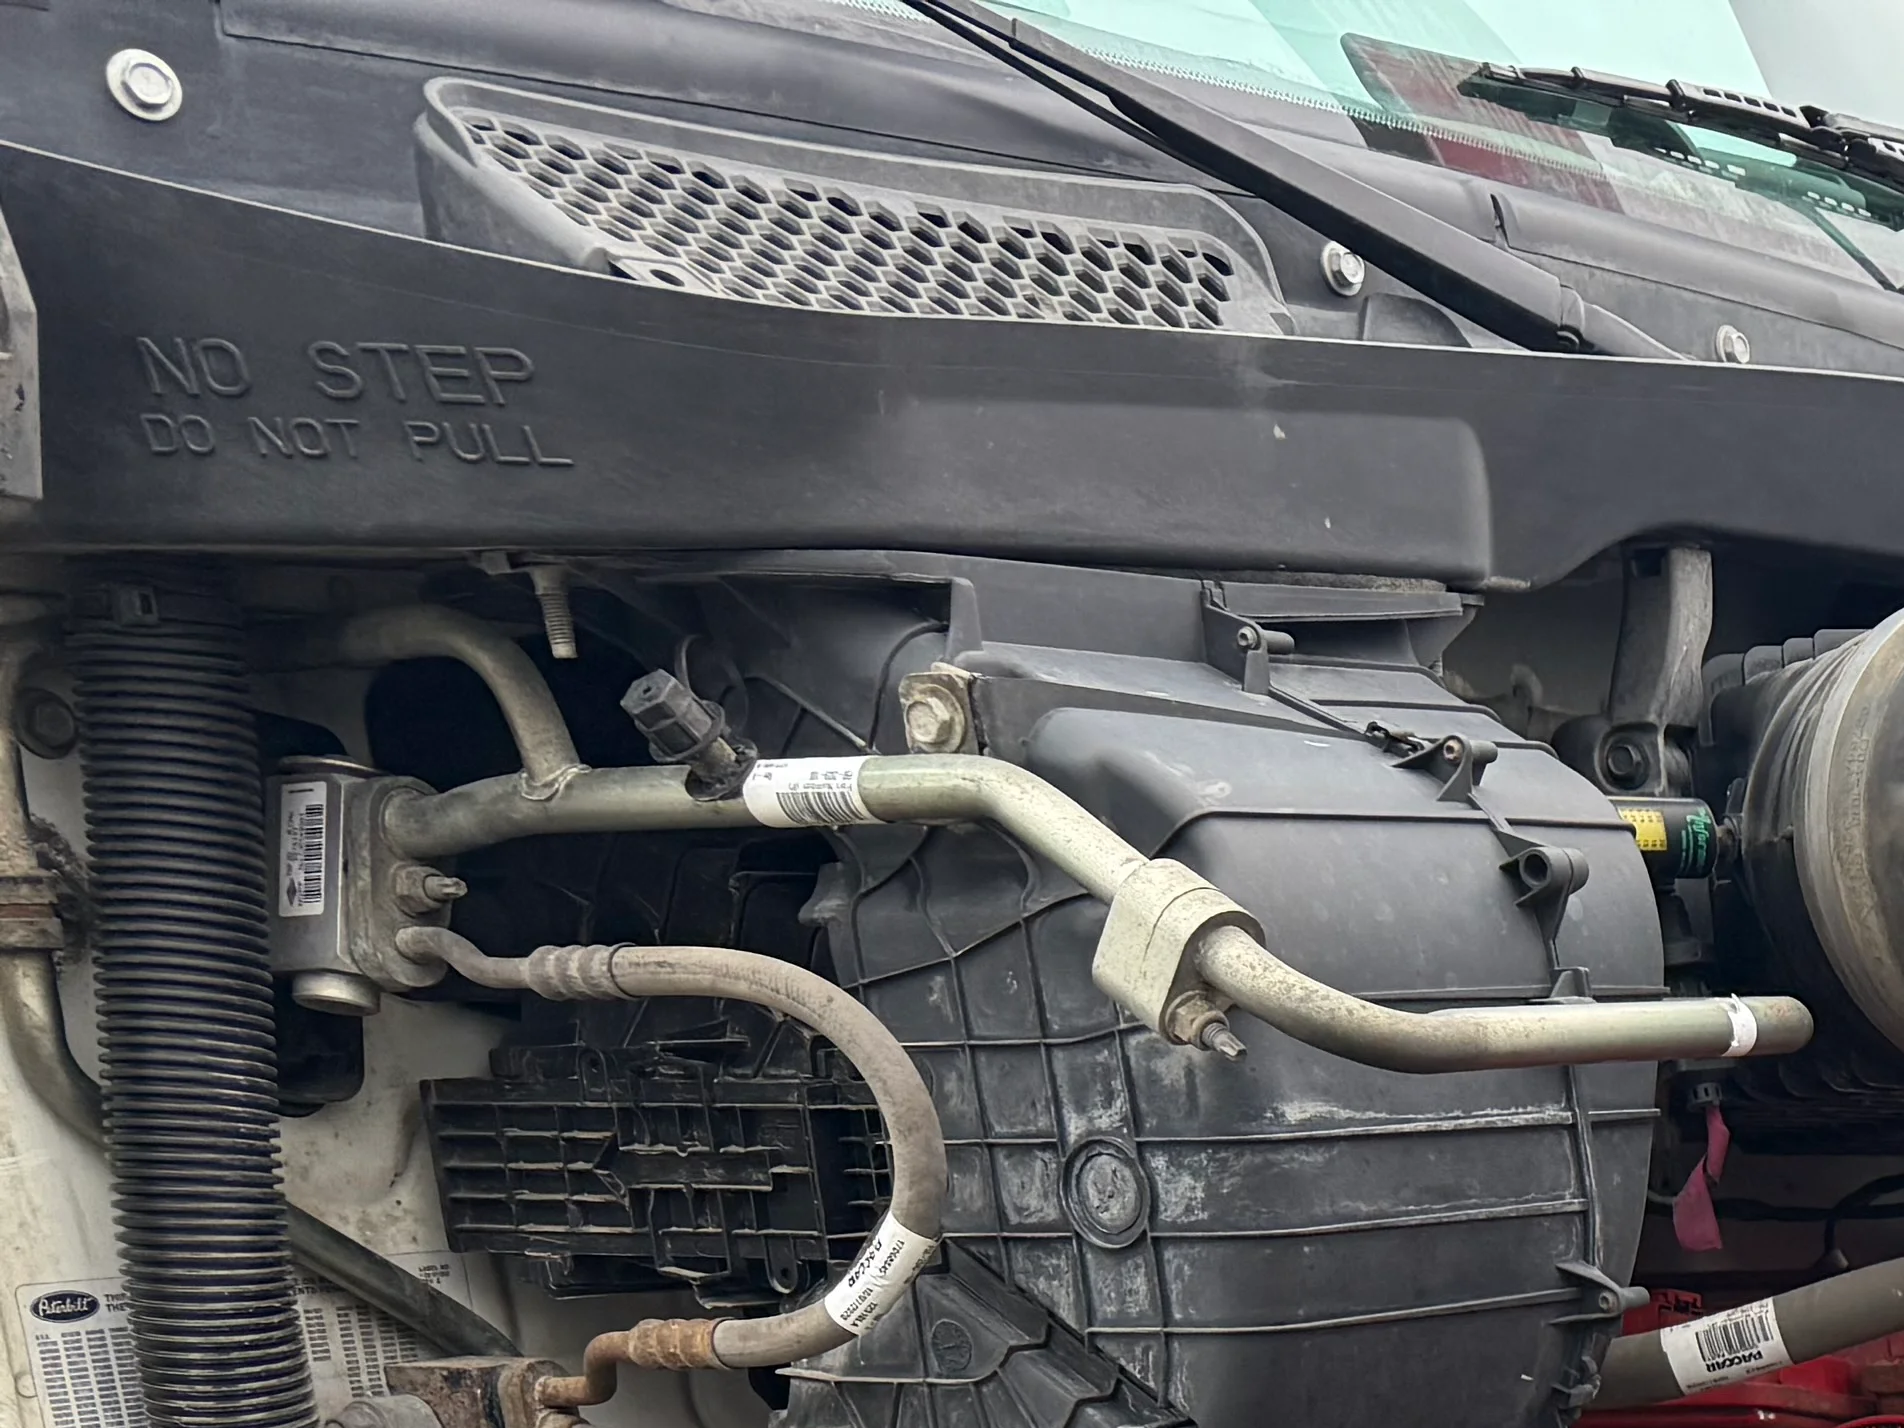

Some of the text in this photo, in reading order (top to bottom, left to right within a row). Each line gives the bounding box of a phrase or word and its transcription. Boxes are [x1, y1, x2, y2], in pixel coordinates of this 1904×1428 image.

[137, 336, 535, 405] NO STEP
[140, 413, 574, 467] DO NOT PULL
[38, 1297, 92, 1316] Peterbilt
[1706, 1350, 1764, 1373] PACCAR
